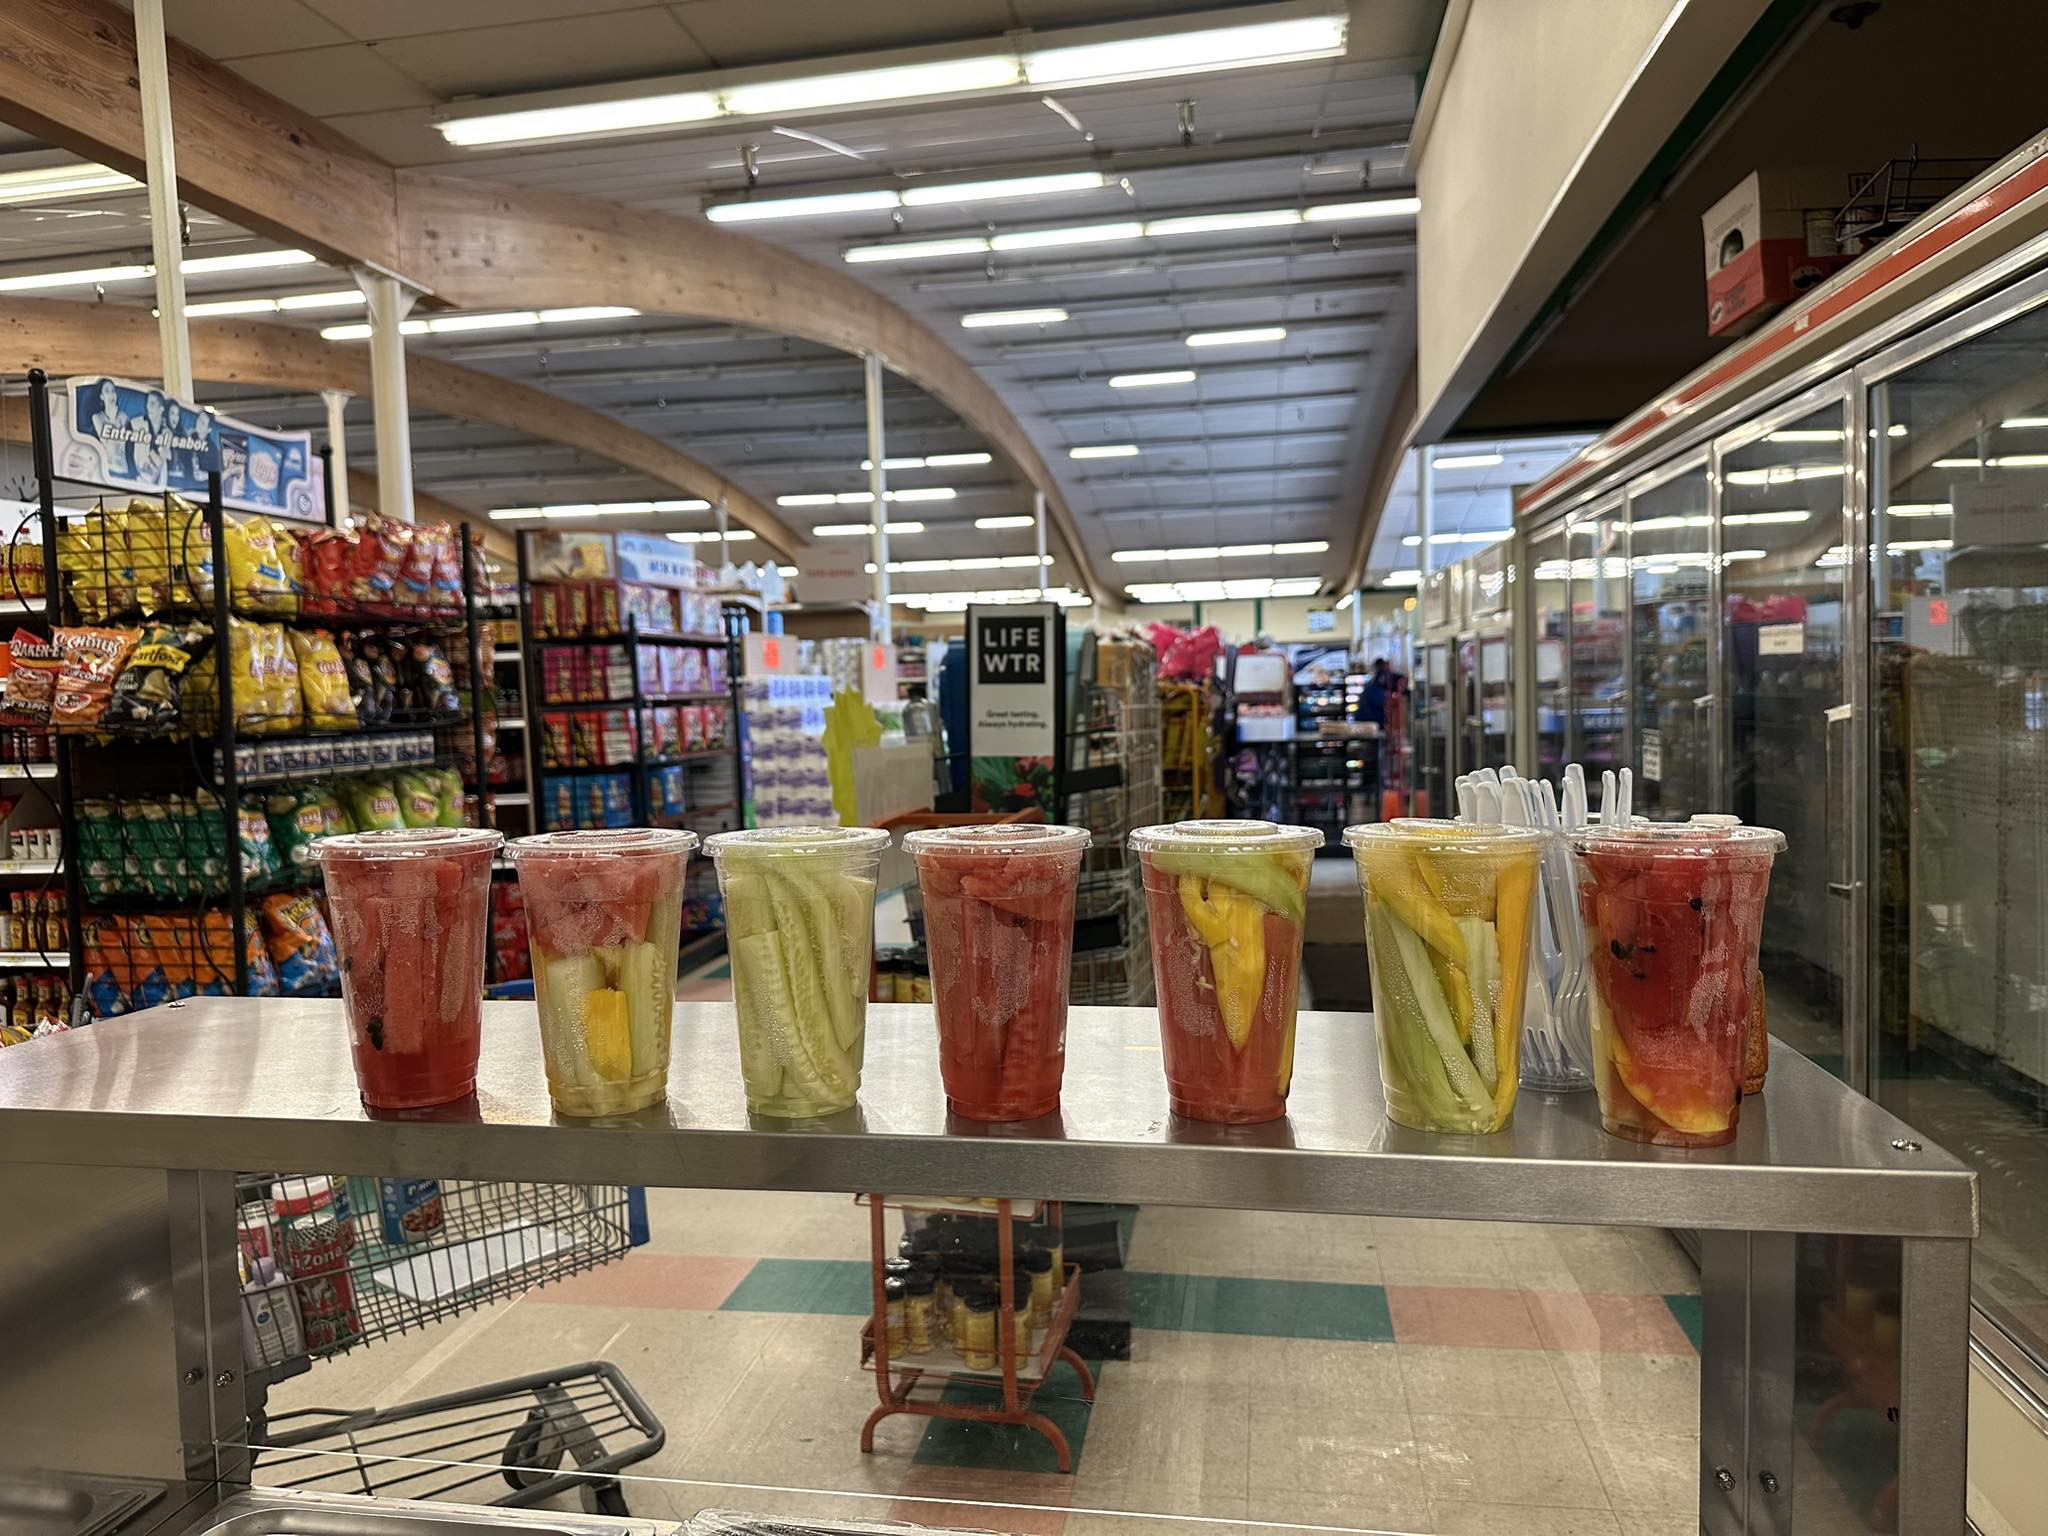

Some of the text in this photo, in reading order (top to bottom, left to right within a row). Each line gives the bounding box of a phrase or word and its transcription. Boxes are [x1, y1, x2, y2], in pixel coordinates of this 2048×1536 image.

[155, 433, 170, 447] al
[172, 437, 209, 452] sabor.
[984, 628, 1040, 647] LIFE
[11, 639, 65, 658] BAKEN-E
[983, 653, 1040, 673] WTR
